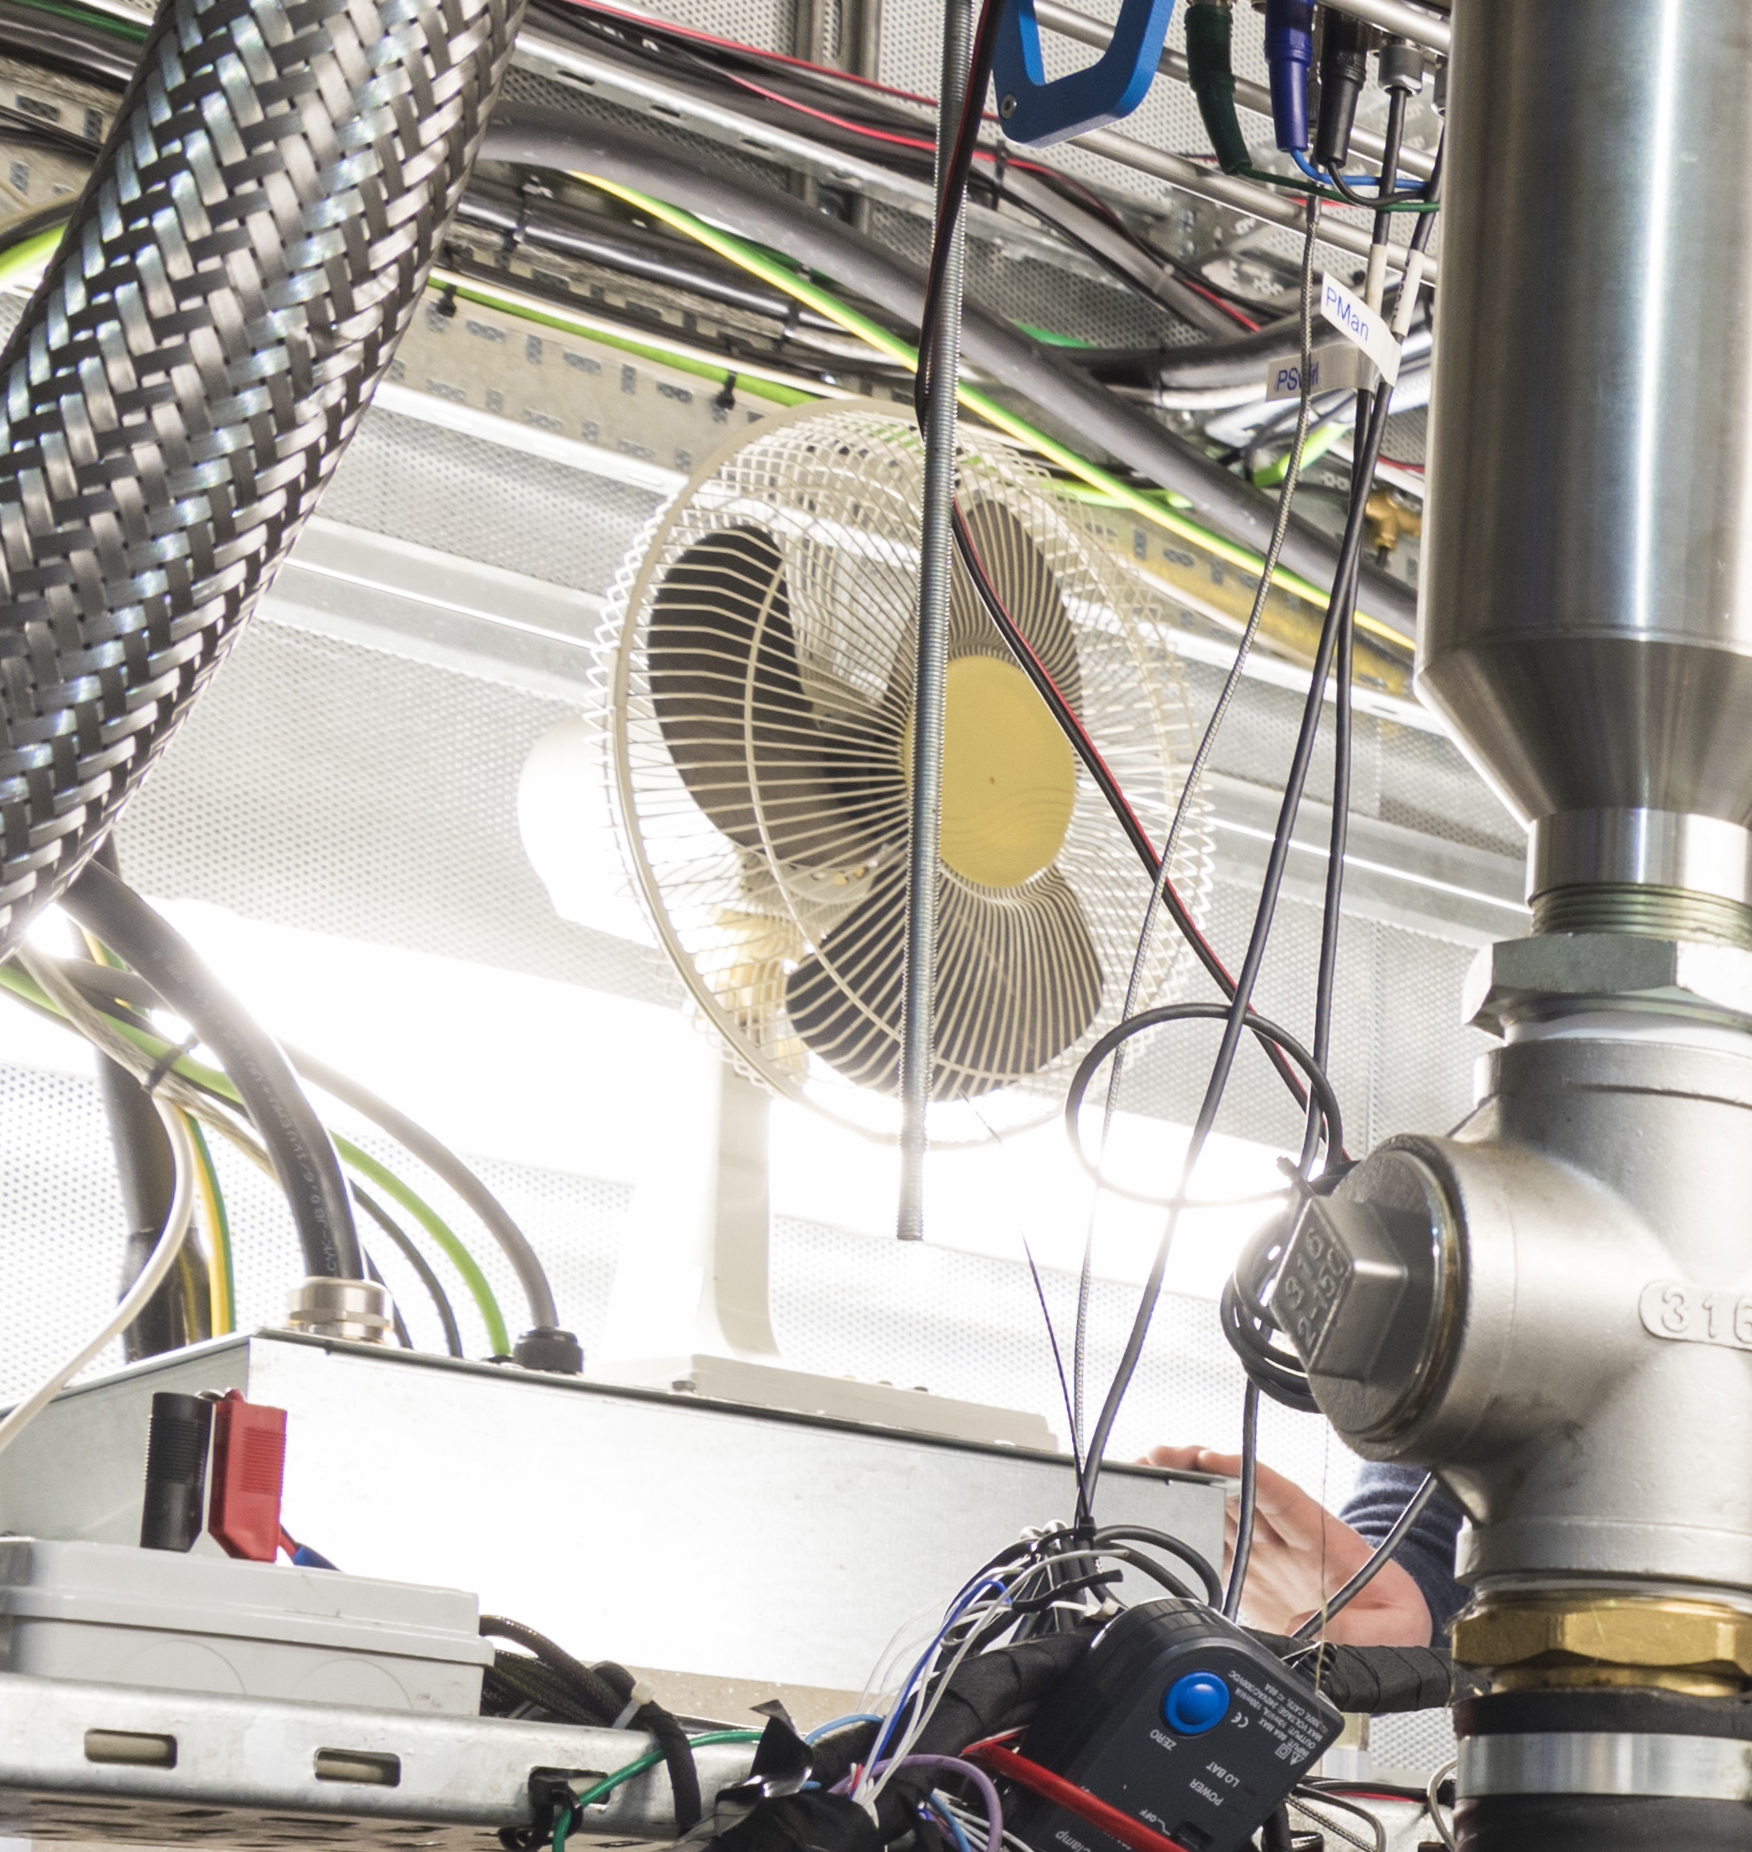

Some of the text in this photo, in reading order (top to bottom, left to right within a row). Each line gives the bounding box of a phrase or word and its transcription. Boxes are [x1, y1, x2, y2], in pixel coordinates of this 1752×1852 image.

[1326, 286, 1370, 341] PMan
[1285, 1227, 1324, 1311] 316
[1257, 1716, 1275, 1732] MAX
[1276, 1705, 1308, 1731] VOLTAGE:
[1150, 1729, 1177, 1751] ZERO
[1306, 1727, 1323, 1742] MAX
[1206, 1761, 1240, 1788] LO BAT
[1189, 1778, 1224, 1807] POWER
[1138, 1806, 1158, 1823] OFF
